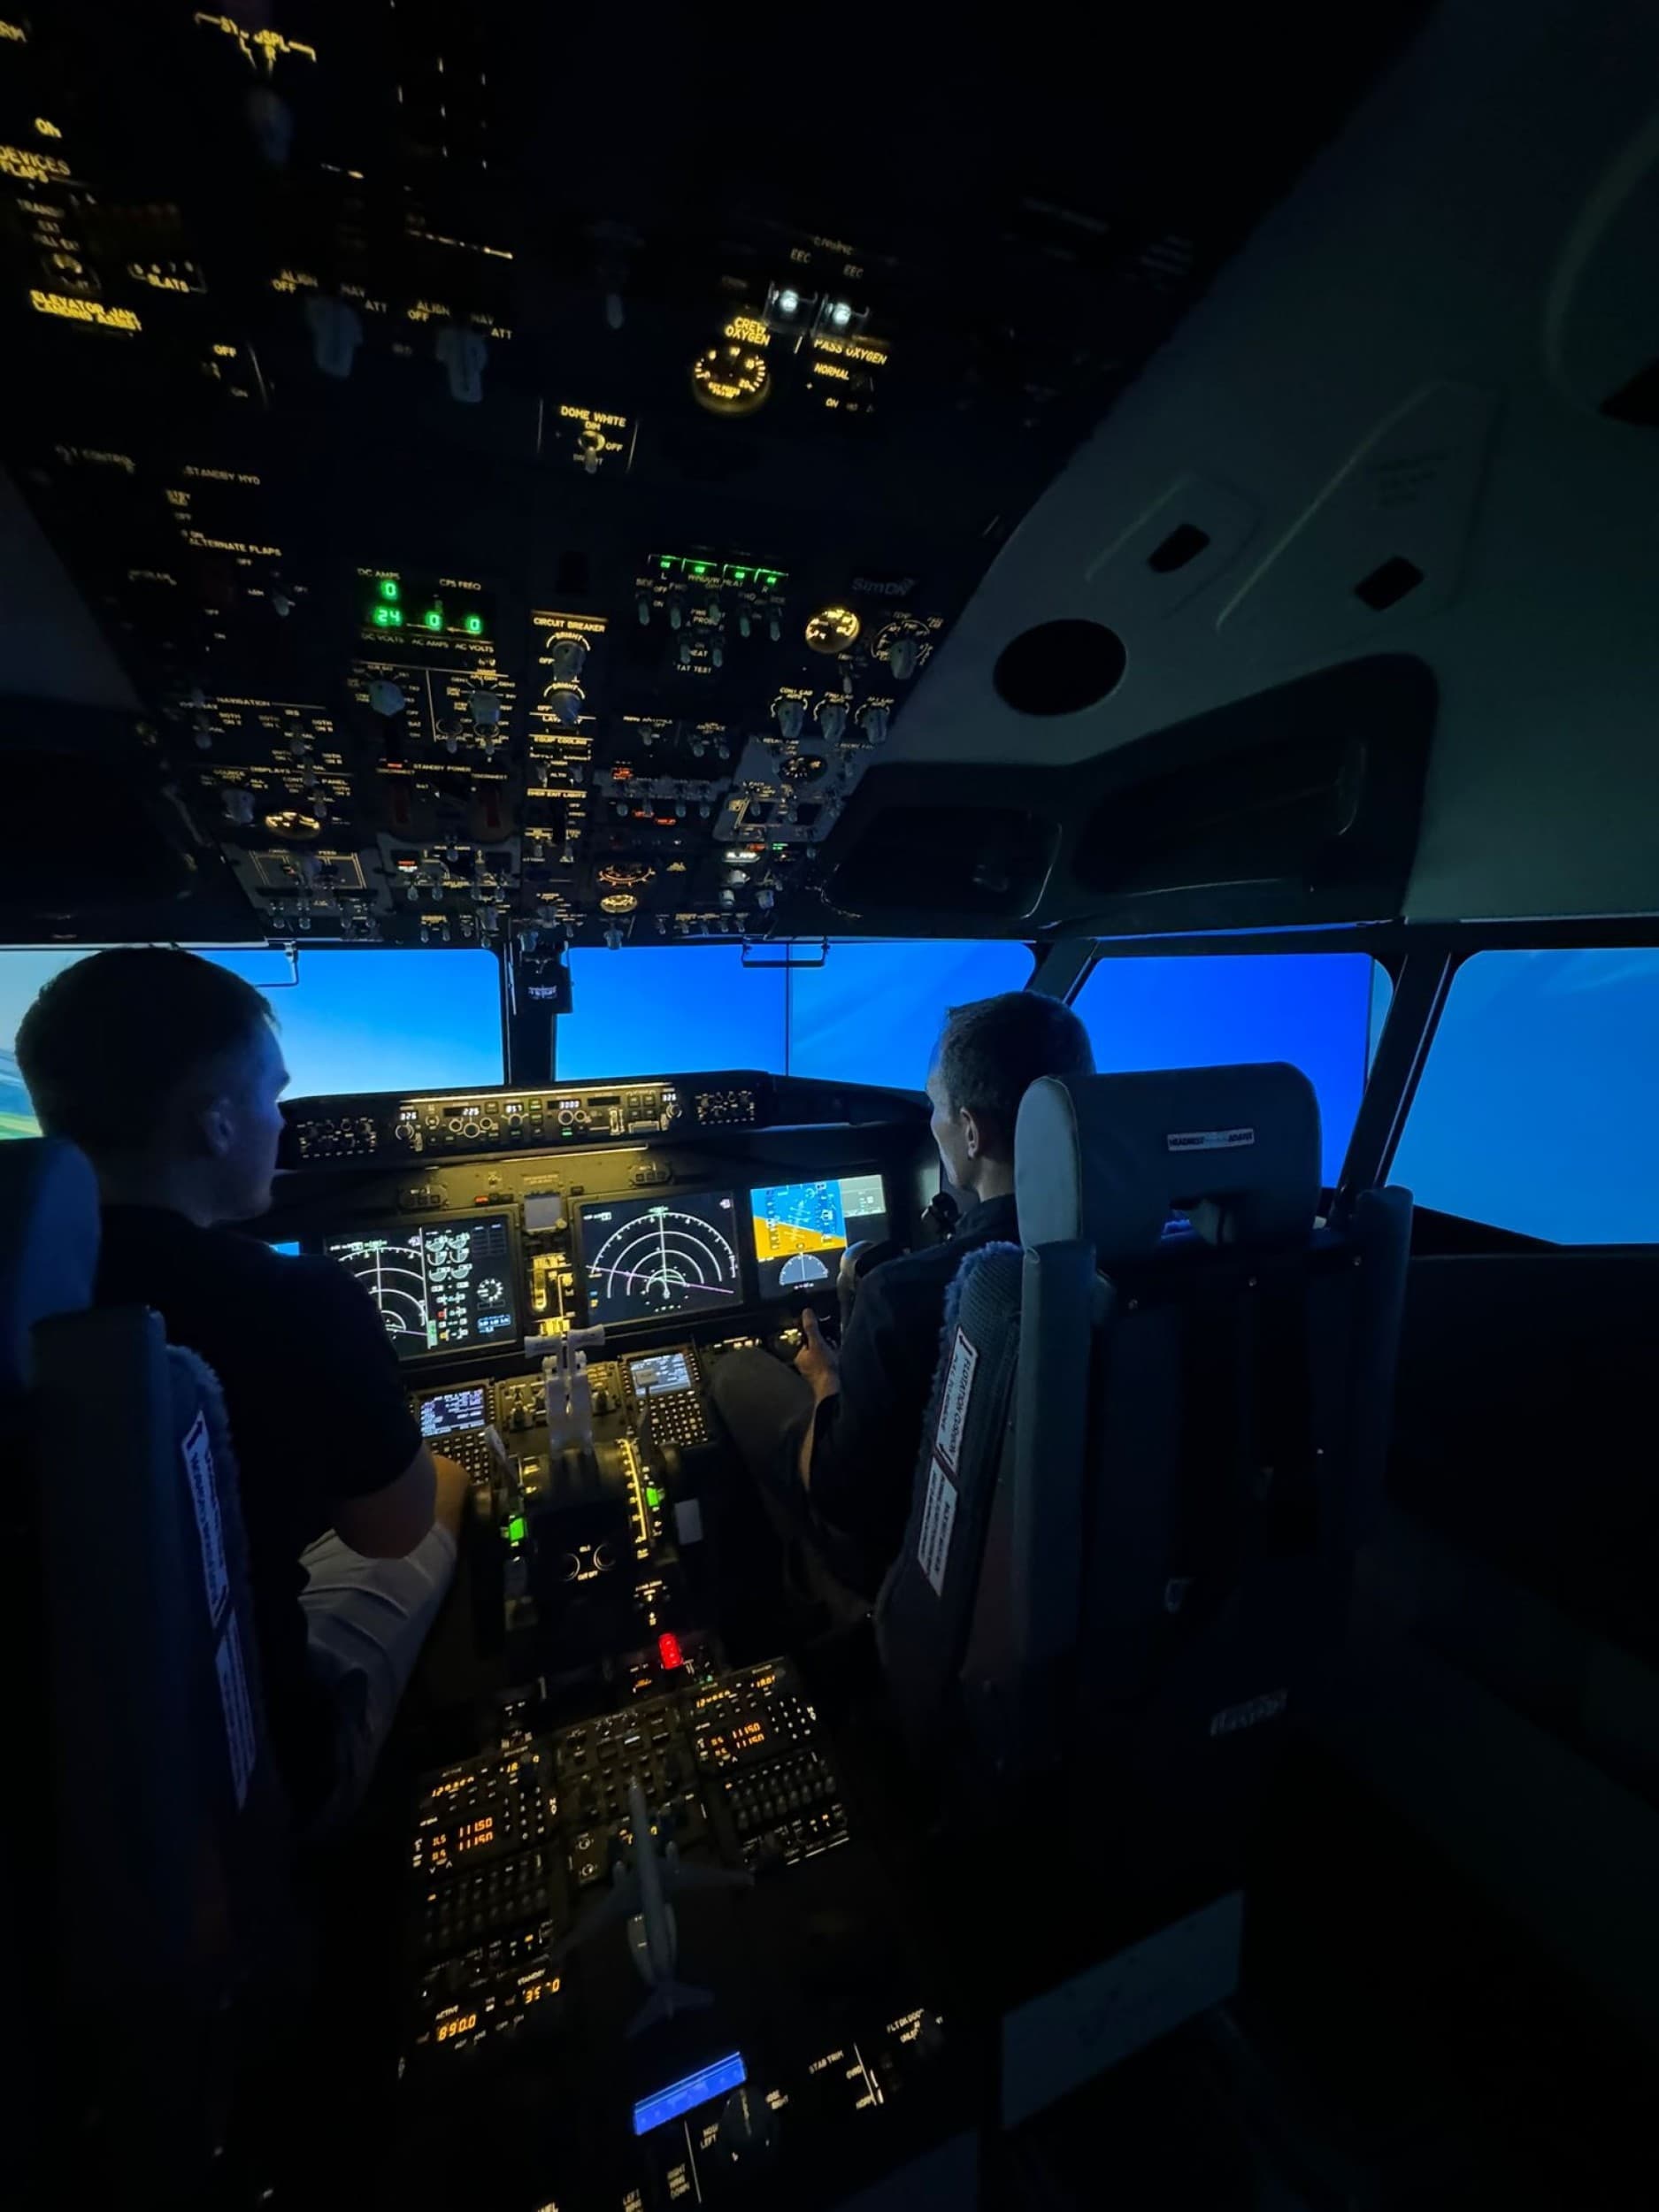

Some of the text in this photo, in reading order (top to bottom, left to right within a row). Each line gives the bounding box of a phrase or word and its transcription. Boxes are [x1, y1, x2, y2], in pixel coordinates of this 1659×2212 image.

[733, 316, 767, 334] CREW
[724, 325, 771, 347] OXYGEN
[845, 344, 888, 366] OXYGEN
[814, 363, 850, 381] NORMAL
[560, 405, 627, 428] DOME WHITE
[385, 582, 396, 596] 0
[377, 609, 401, 623] 24
[533, 618, 605, 633] CIRCUIT BREAKER
[809, 2050, 844, 2074] STAB TRIM
